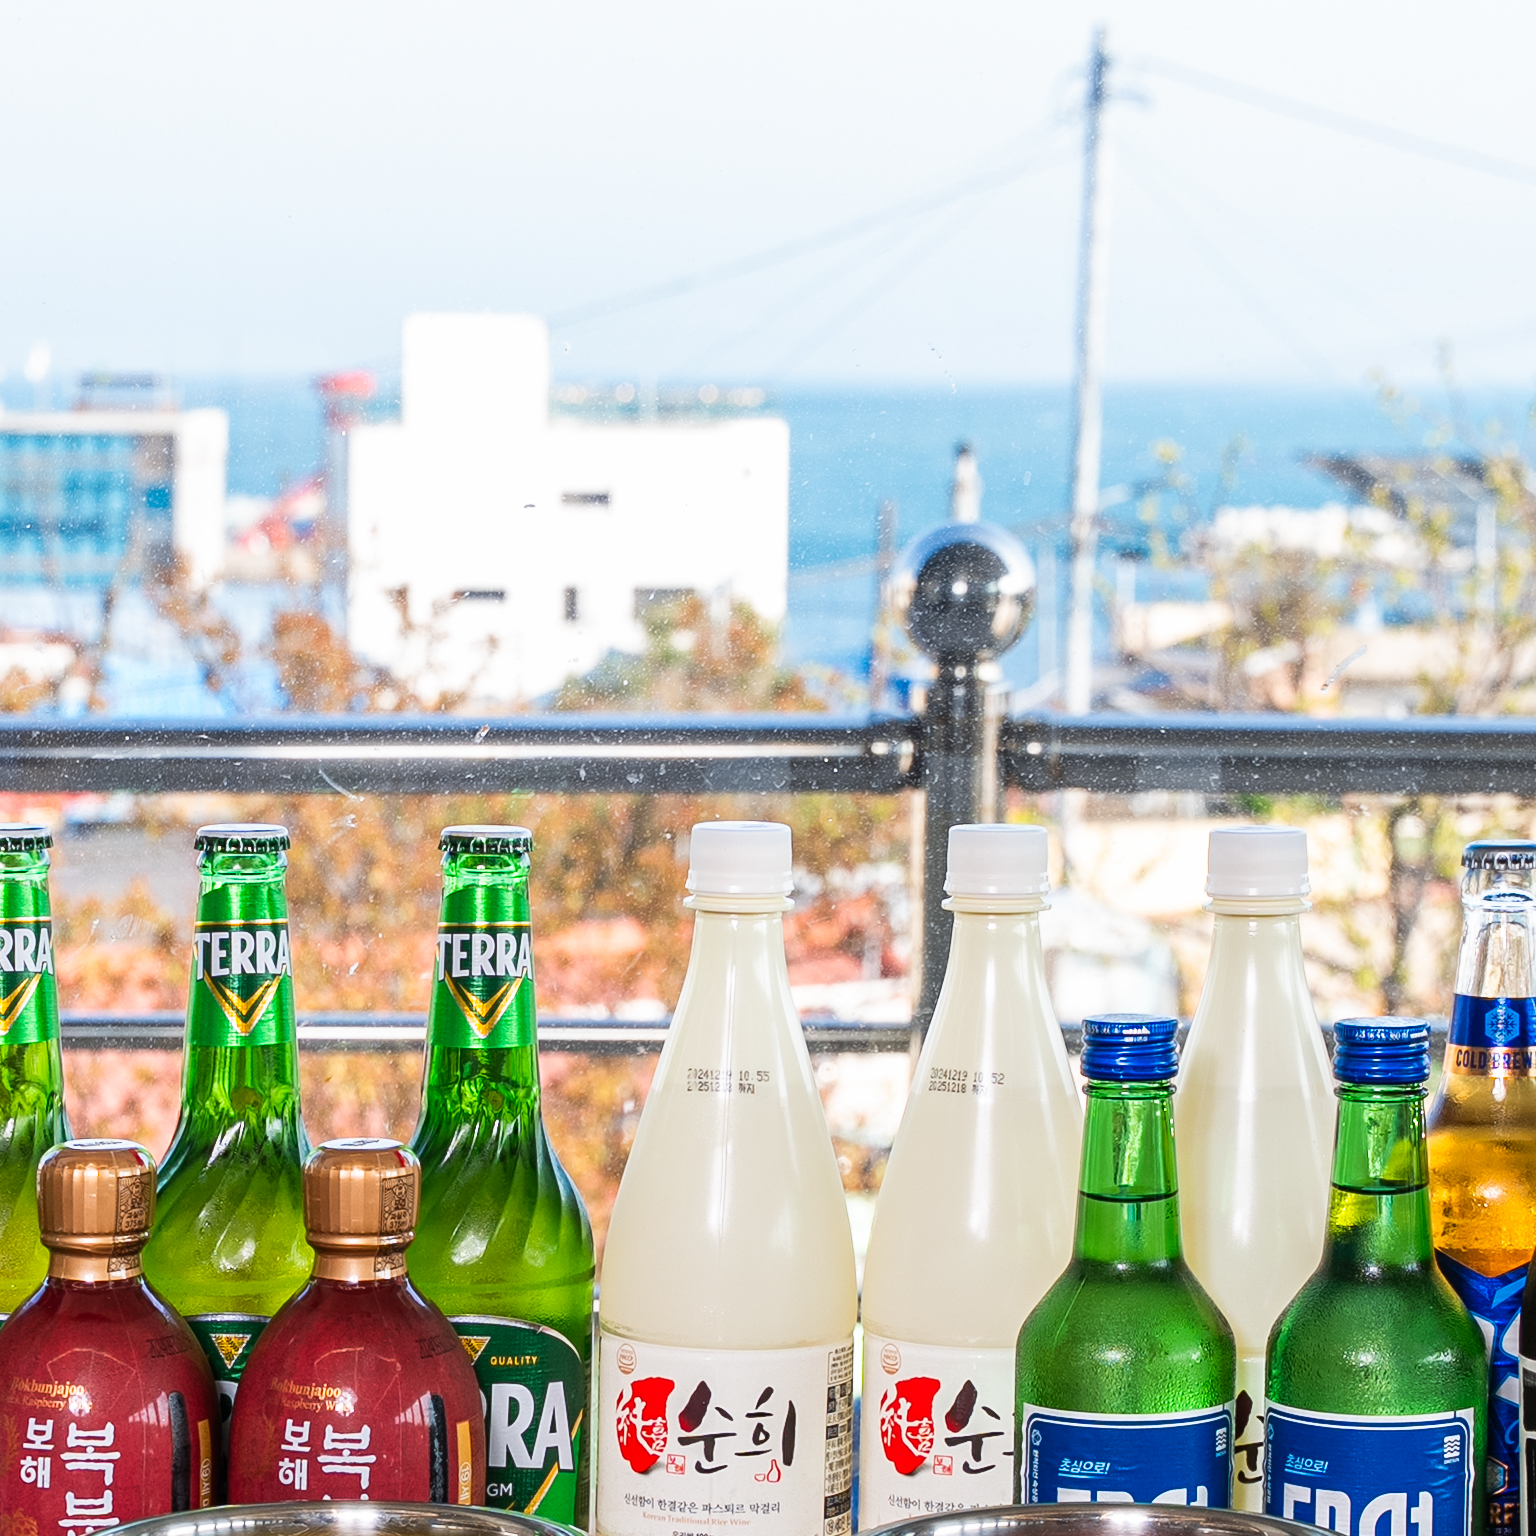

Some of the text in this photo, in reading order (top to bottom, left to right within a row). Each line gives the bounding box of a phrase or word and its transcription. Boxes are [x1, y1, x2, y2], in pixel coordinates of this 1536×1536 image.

[193, 929, 292, 981] TERRA
[437, 932, 533, 981] TERRA
[1456, 1049, 1487, 1068] COLD
[928, 1081, 967, 1093] 20251218
[490, 1355, 538, 1366] QUALITY
[10, 1376, 85, 1399] Bokbunjajoo
[270, 1377, 342, 1400] Bokbunjajoo
[676, 1379, 797, 1475] 순희
[944, 1379, 1015, 1474] 순
[20, 1417, 55, 1489] 보해
[278, 1418, 312, 1491] 보해
[317, 1424, 377, 1501] 복
[1284, 1453, 1329, 1474] 초심으로!
[1058, 1458, 1111, 1475] 초심으로!
[623, 1493, 781, 1515] 신선함이 한결같은 파스퇴르 막걸리
[887, 1494, 921, 1512] 신선함이
[642, 1511, 752, 1527] Korean Traditional Rice Wine
